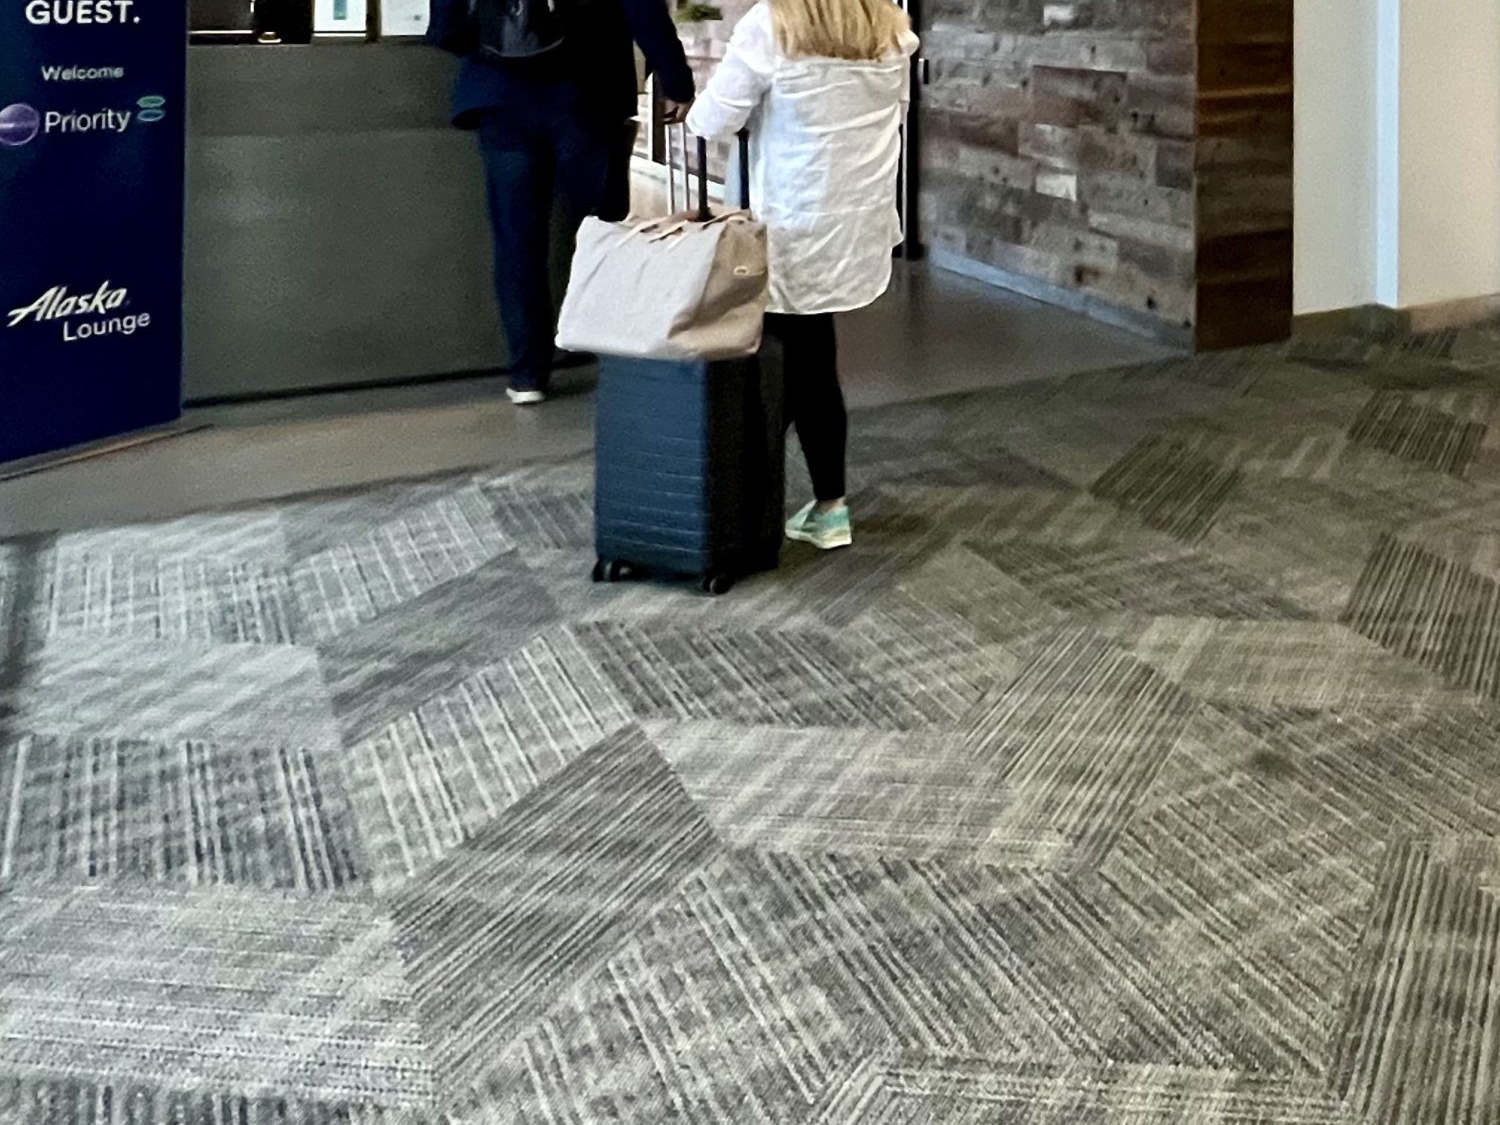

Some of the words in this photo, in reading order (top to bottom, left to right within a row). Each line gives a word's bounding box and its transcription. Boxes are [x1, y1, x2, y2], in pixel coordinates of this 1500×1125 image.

[25, 0, 141, 25] GUEST.
[41, 65, 125, 82] Welcome
[44, 107, 132, 134] Priority
[7, 280, 128, 328] Alaska
[63, 312, 151, 342] Lounge
